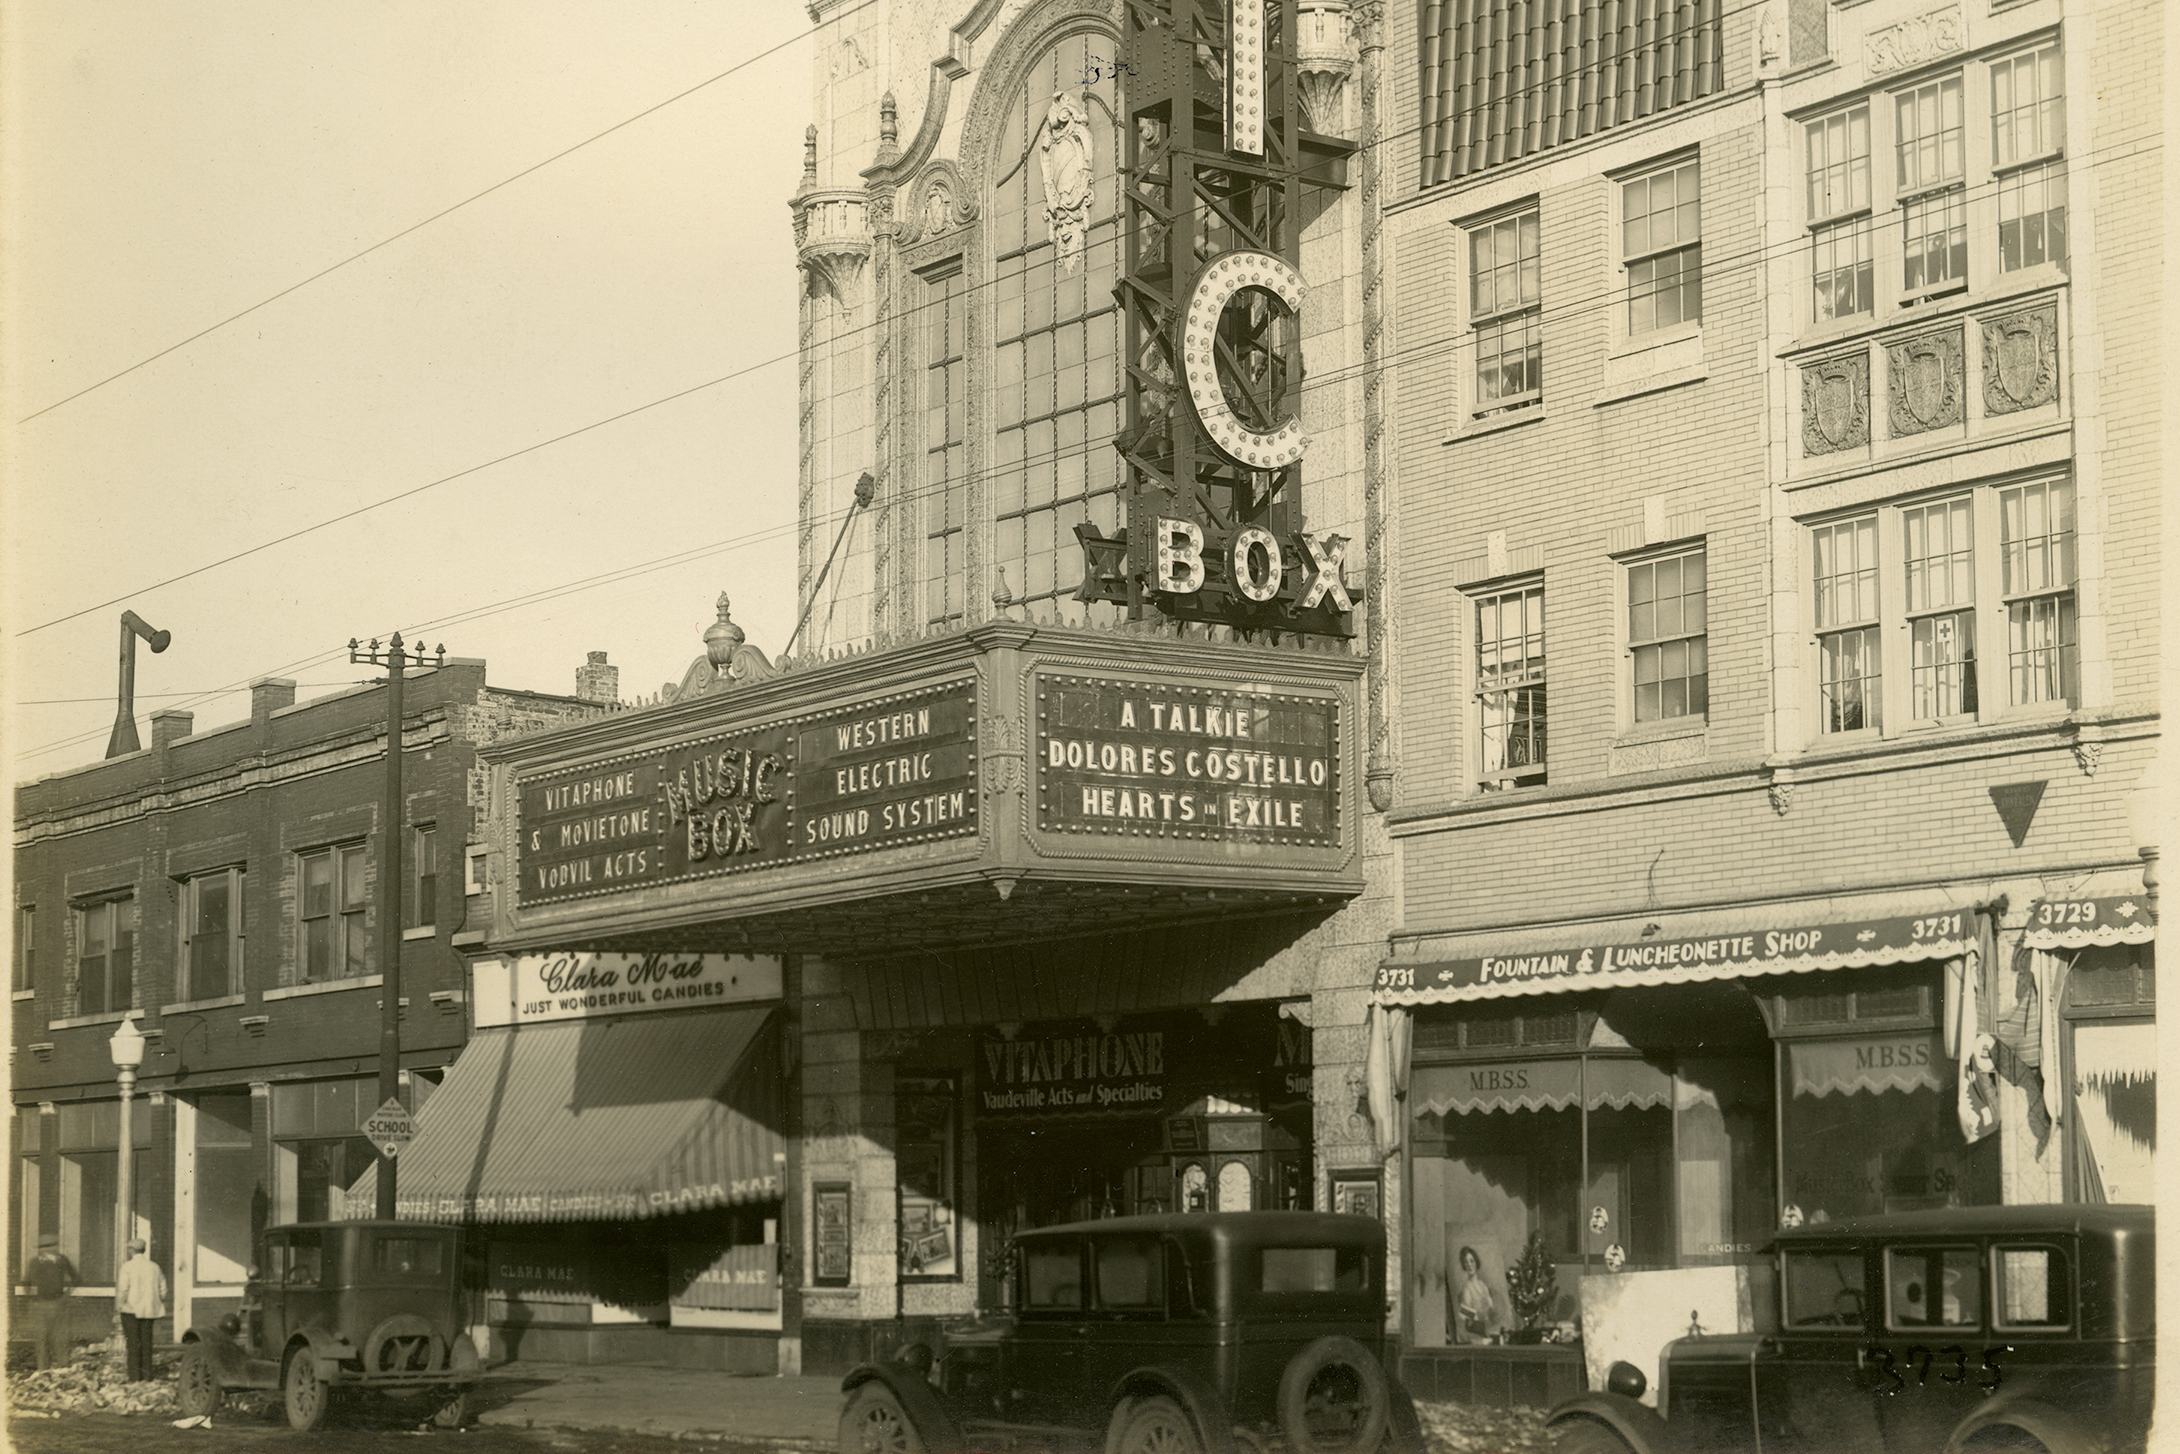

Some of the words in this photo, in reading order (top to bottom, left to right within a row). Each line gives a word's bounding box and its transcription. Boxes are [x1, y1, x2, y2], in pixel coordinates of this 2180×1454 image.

[1155, 515, 1354, 612] BOX
[837, 707, 930, 751] WESTERN
[1120, 700, 1138, 728] A
[1149, 701, 1251, 738] TALKIE
[837, 753, 933, 795] ELECTRIC
[1048, 739, 1177, 776] DOLORES
[1185, 749, 1326, 787] COSTELLO
[545, 770, 635, 811] VITAPHONE
[666, 748, 780, 825] MUSIC
[806, 807, 870, 844] SOUND
[884, 790, 965, 831] SYSTEM
[1082, 786, 1197, 822] HEARTS
[1204, 803, 1217, 816] IN
[1229, 798, 1304, 829] EXILE
[531, 831, 541, 851] &
[560, 808, 650, 846] MOVIETONE
[686, 801, 761, 863] BOX
[538, 857, 592, 890] VODVIL
[603, 850, 648, 879] ACTS
[2037, 902, 2097, 925] 3729
[1377, 968, 1415, 987] 3731
[1479, 954, 1570, 983] FOUNTAIN
[1575, 948, 1595, 974] &
[1602, 936, 1754, 972] LUNCHEONETTE
[1765, 930, 1823, 957] SHOP
[1911, 914, 1961, 940] 3731
[539, 958, 620, 994] Clara
[627, 953, 704, 985] Mae
[522, 1000, 552, 1015] JUST
[559, 991, 646, 1012] WONDERFUL
[652, 982, 725, 1001] CANDIES
[984, 1032, 1164, 1084] VITAPHONE
[983, 1089, 1045, 1110] Vaudeville
[1048, 1087, 1075, 1106] Acts
[1075, 1085, 1094, 1104] and
[1097, 1082, 1164, 1106] Specialties
[368, 1120, 413, 1134] SCHOOL
[504, 1197, 542, 1213] MAE
[650, 1183, 725, 1206] CLARA
[731, 1176, 777, 1195] MAE
[1700, 1243, 1752, 1253] CANDIES
[500, 1264, 542, 1280] CLARA
[547, 1266, 575, 1281] MAE
[734, 1269, 767, 1285] MAE
